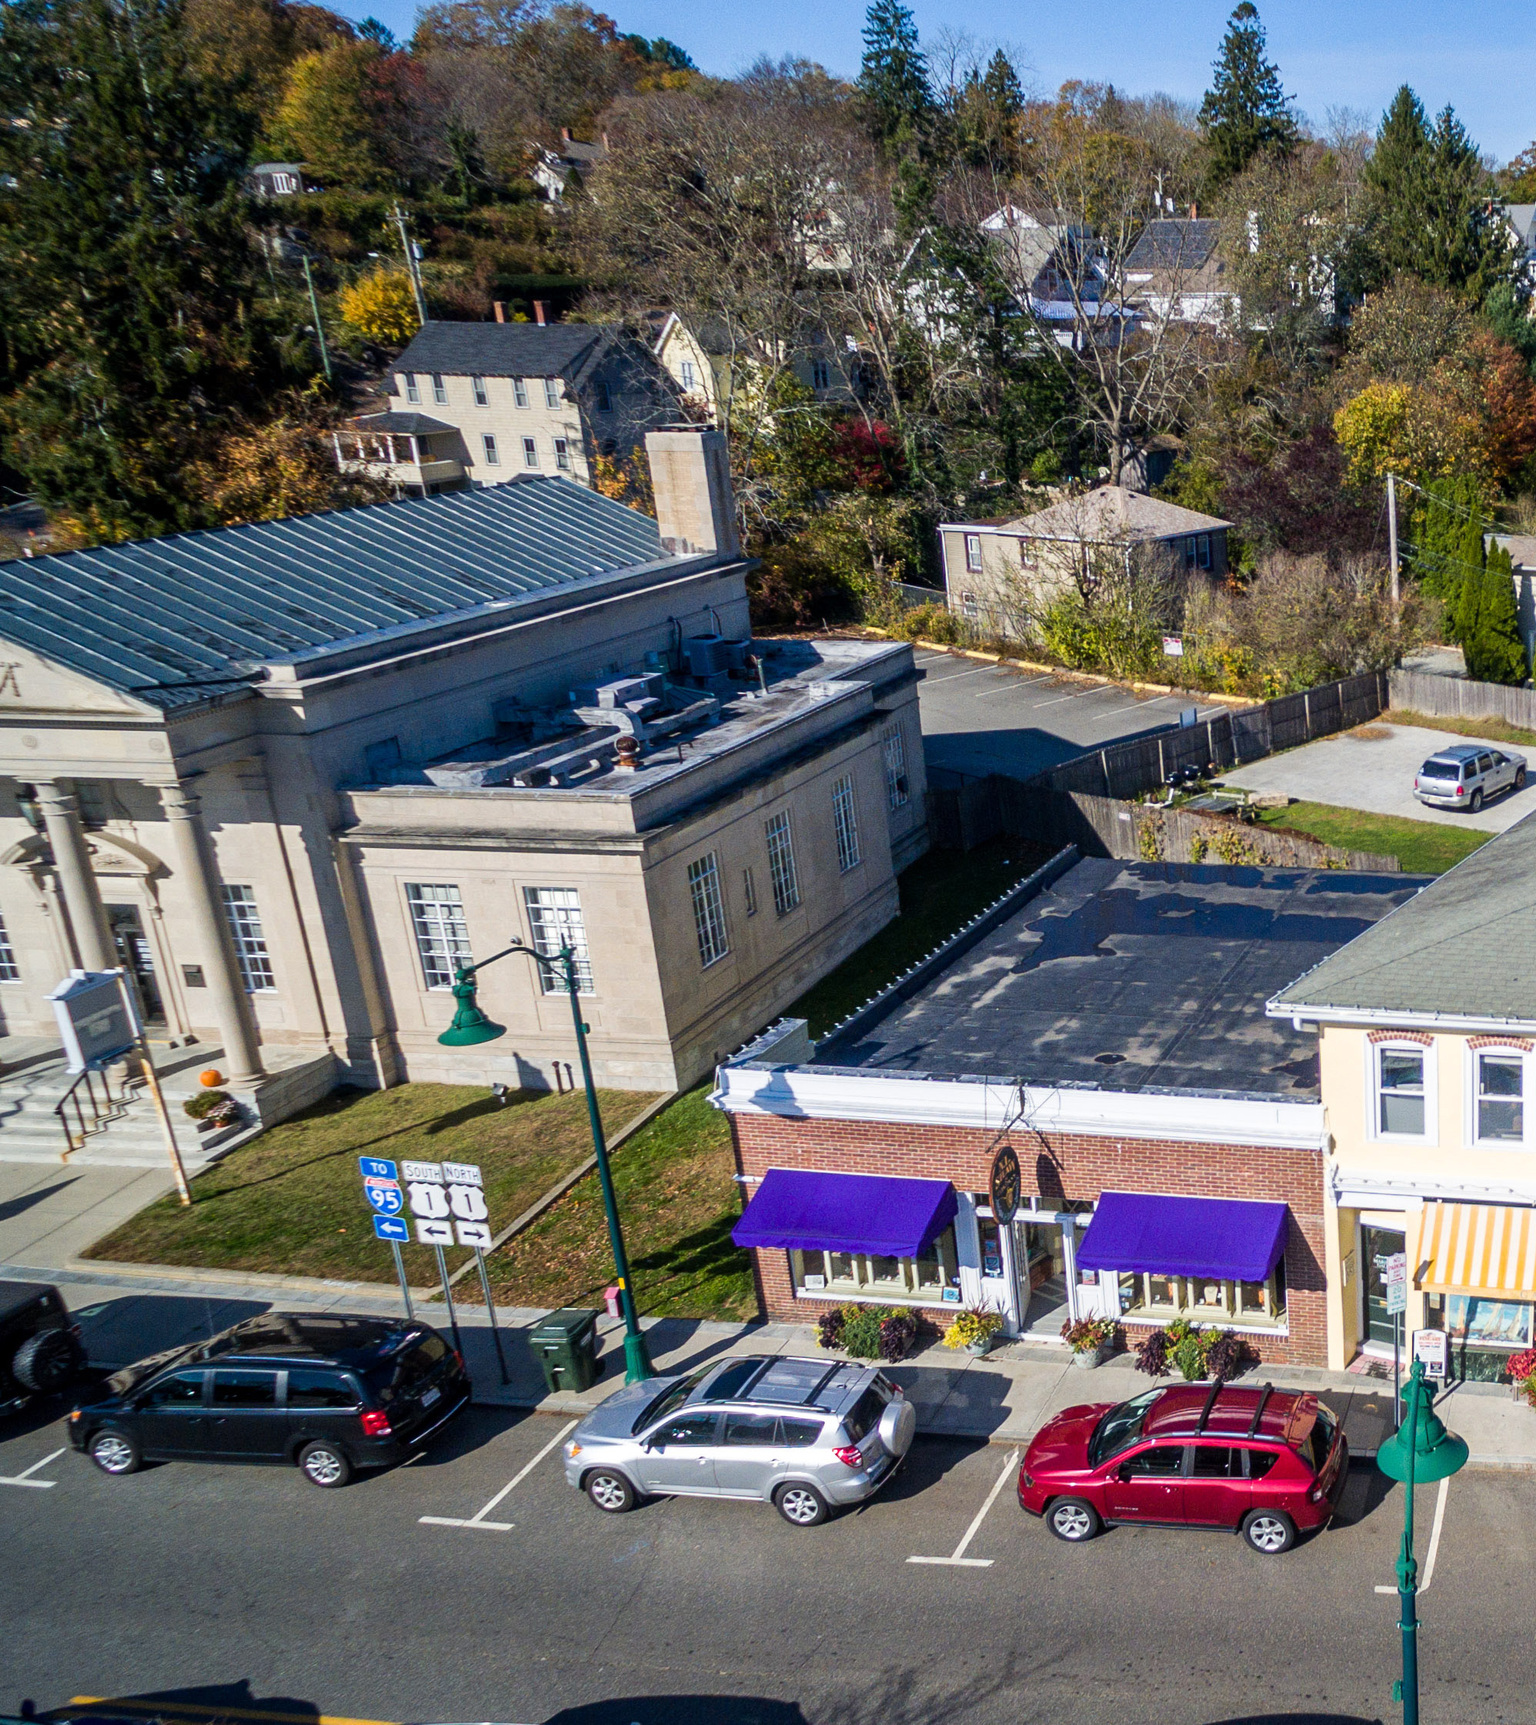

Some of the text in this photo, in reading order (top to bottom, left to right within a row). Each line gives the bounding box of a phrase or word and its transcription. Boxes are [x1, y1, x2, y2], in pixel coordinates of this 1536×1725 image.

[369, 1162, 388, 1175] TO
[406, 1165, 440, 1179] SOUTH
[445, 1166, 479, 1180] NORTH
[371, 1189, 400, 1210] 95
[425, 1191, 433, 1211] 1
[464, 1193, 472, 1213] 1
